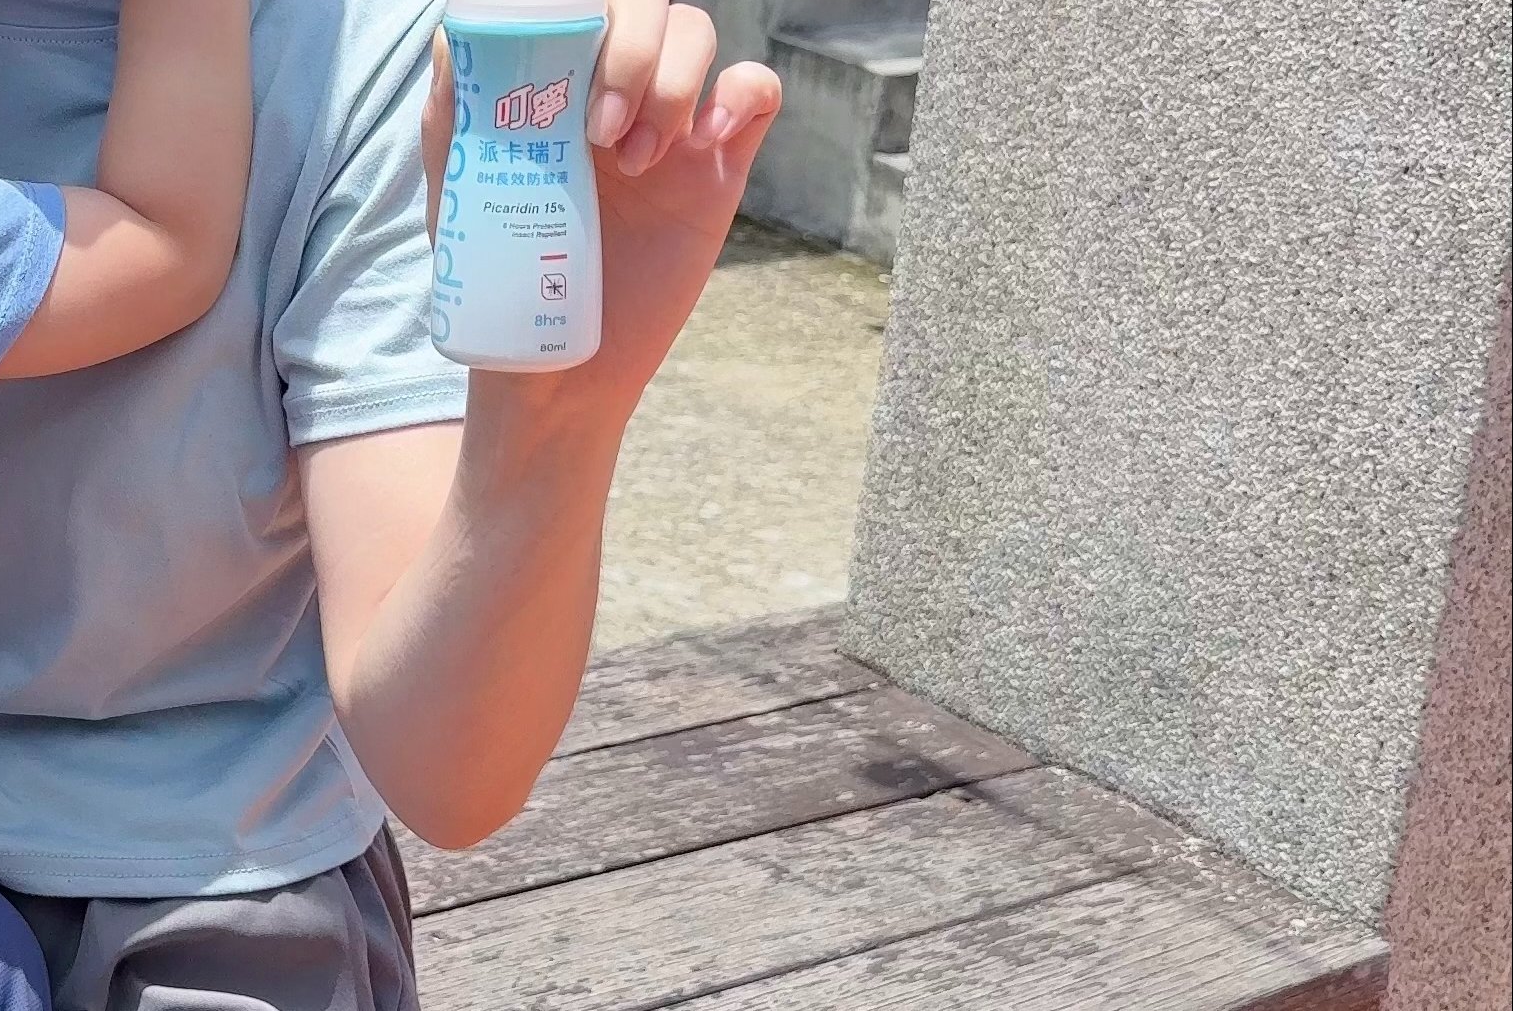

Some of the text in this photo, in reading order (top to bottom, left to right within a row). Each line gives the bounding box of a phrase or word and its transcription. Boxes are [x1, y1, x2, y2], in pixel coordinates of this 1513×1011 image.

[479, 139, 571, 164] 派卡瑞丁
[483, 201, 566, 214] Picaridin 15%
[535, 314, 567, 327] 8hrs
